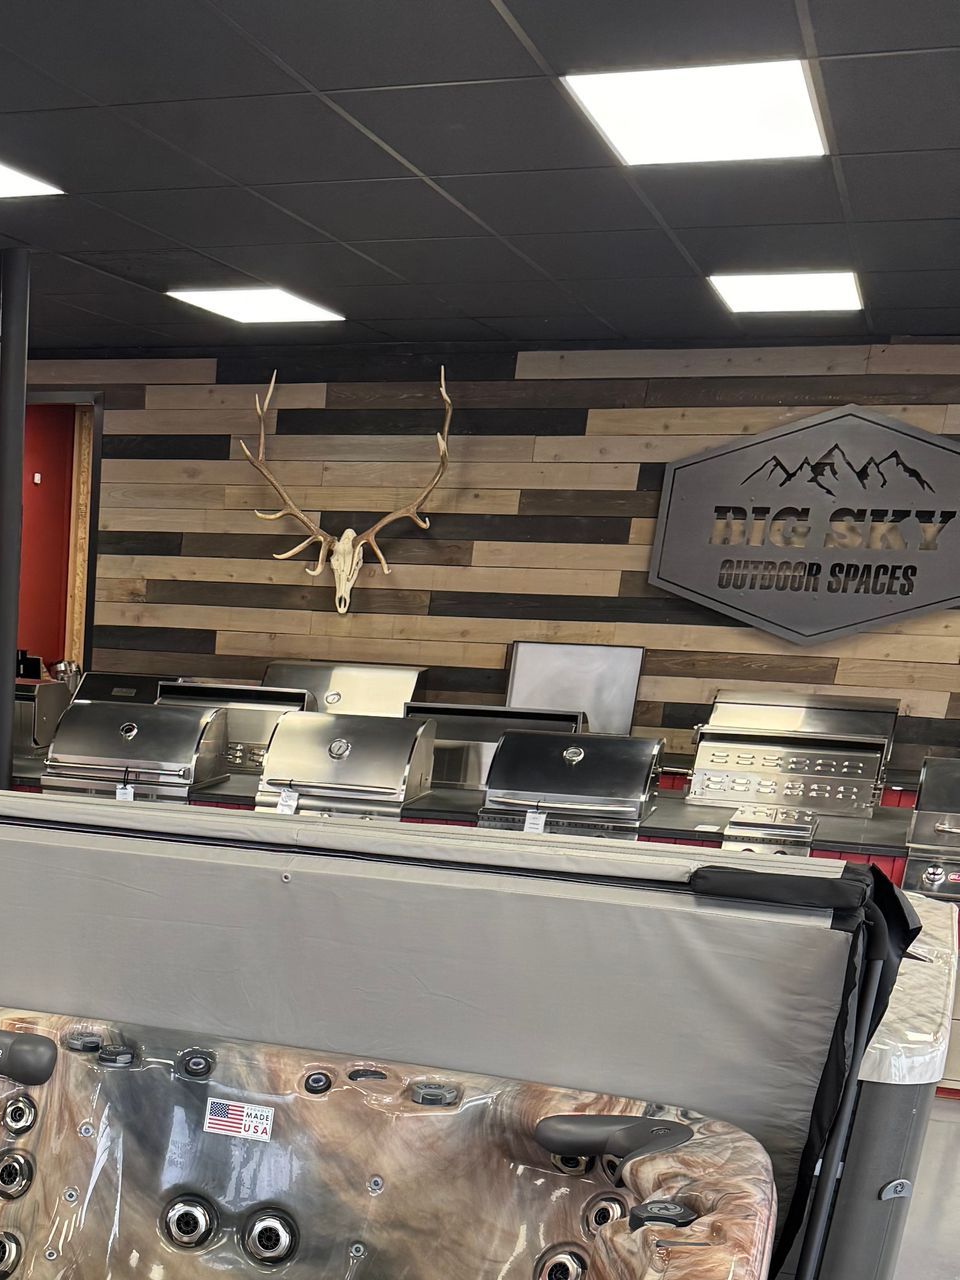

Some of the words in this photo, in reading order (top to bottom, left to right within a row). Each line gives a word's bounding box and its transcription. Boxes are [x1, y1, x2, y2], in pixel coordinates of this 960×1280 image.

[708, 505, 812, 548] BIG
[823, 507, 957, 551] SKY
[717, 558, 822, 593] OUTDOOR
[827, 562, 918, 596] SPACES
[245, 1112, 270, 1121] MADE
[243, 1124, 268, 1136] USA
